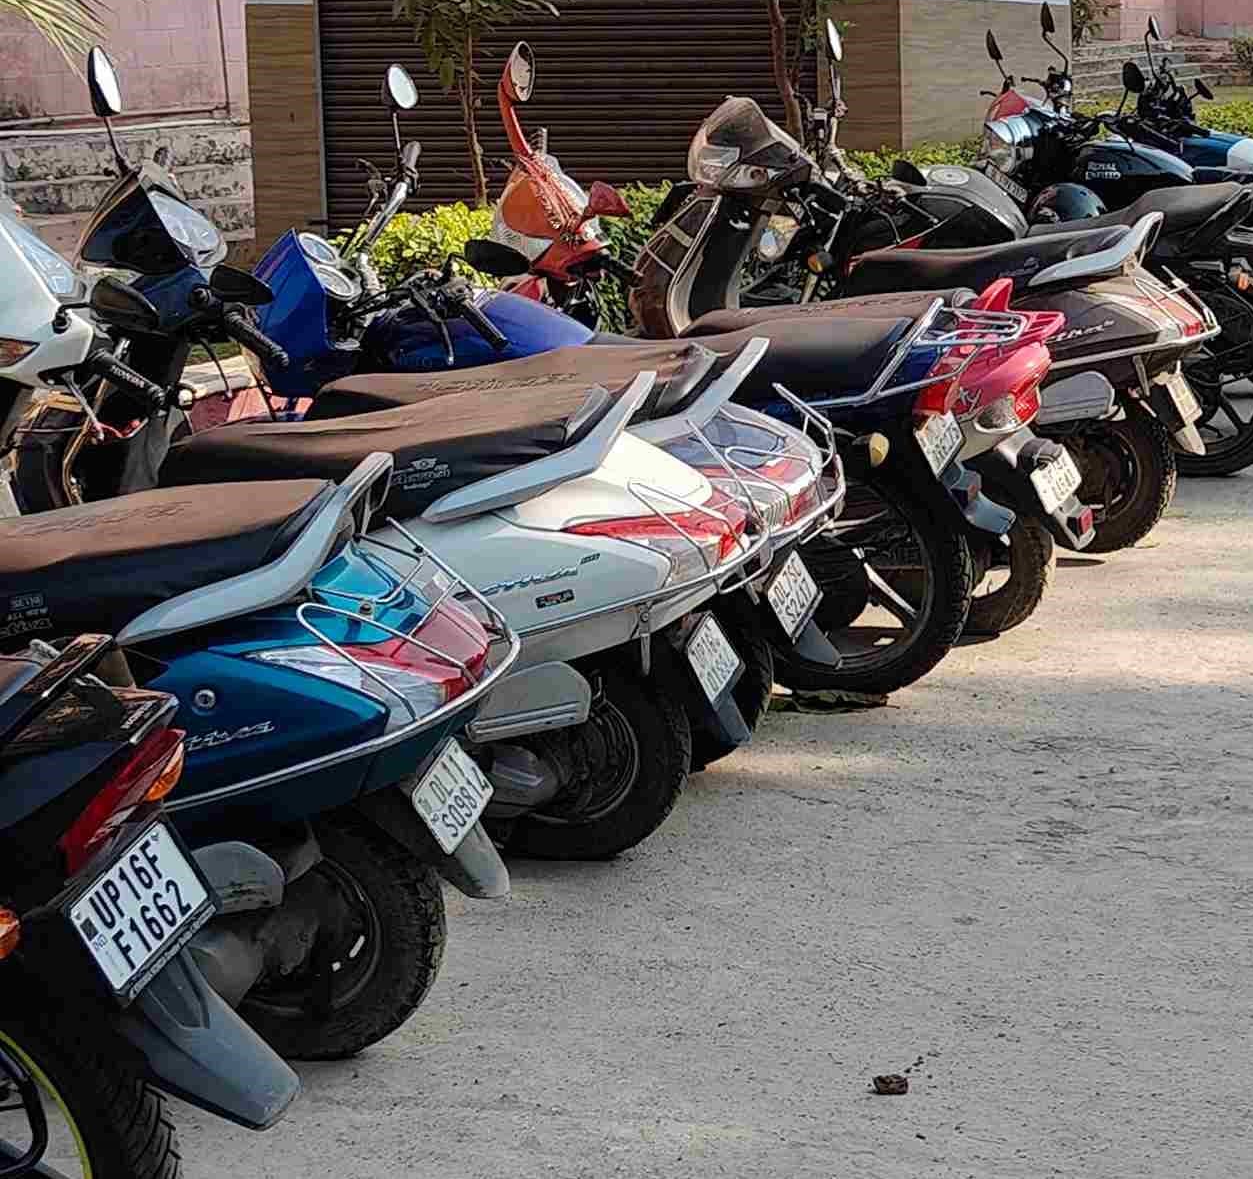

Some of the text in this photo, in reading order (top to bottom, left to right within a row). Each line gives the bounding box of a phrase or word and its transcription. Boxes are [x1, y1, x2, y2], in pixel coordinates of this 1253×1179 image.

[111, 364, 145, 389] HONDA
[88, 839, 163, 930] UP16F
[111, 878, 193, 971] F1662
